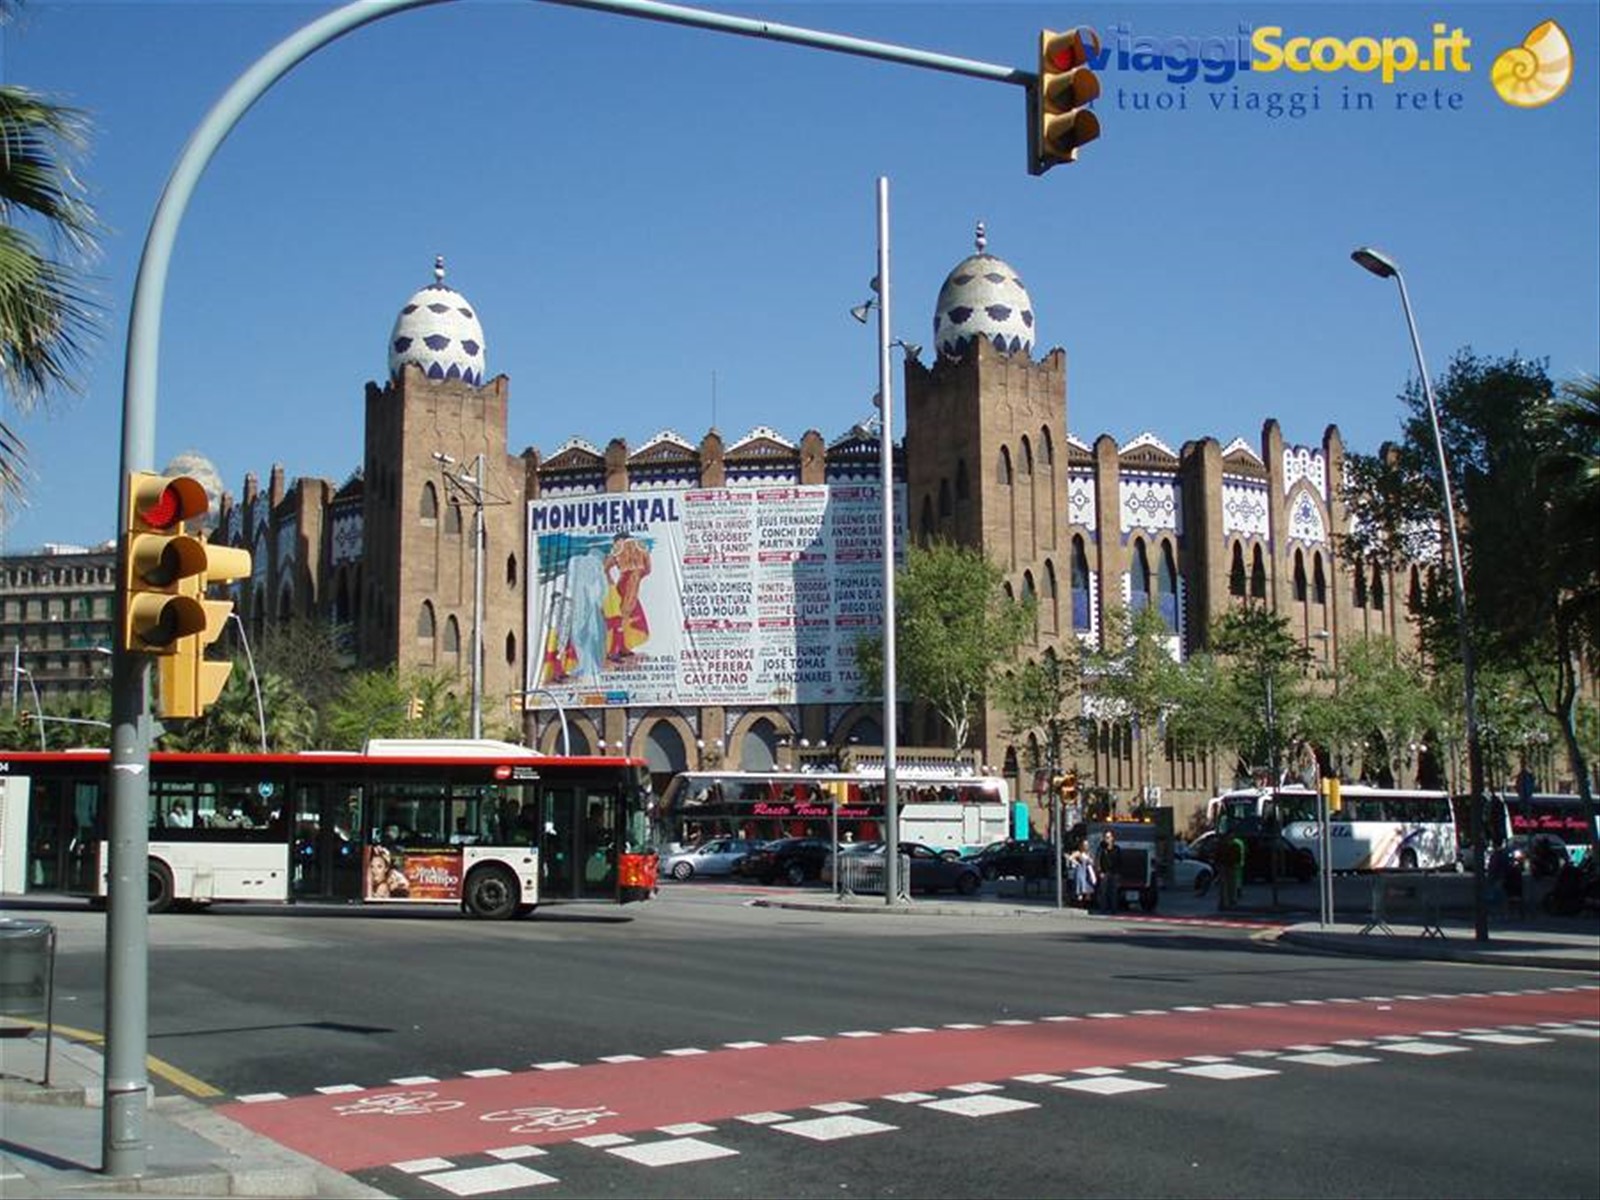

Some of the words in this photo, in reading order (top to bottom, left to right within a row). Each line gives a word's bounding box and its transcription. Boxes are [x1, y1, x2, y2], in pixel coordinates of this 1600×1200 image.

[532, 498, 679, 530] MONUMENTAL
[779, 515, 825, 526] FERNANDEZ
[597, 523, 649, 534] BARCELONA
[762, 528, 797, 538] CONCHI
[759, 539, 793, 549] MARTIN
[683, 583, 718, 593] ANTONIO
[682, 595, 708, 606] DIEGO
[713, 606, 748, 616] MOURA
[723, 649, 754, 659] PONCE
[708, 661, 753, 672] PERERA
[789, 658, 826, 669] TOMAS
[600, 673, 648, 682] TEMPORADA
[684, 673, 748, 685] CAYETANO
[794, 801, 828, 815] Tours
